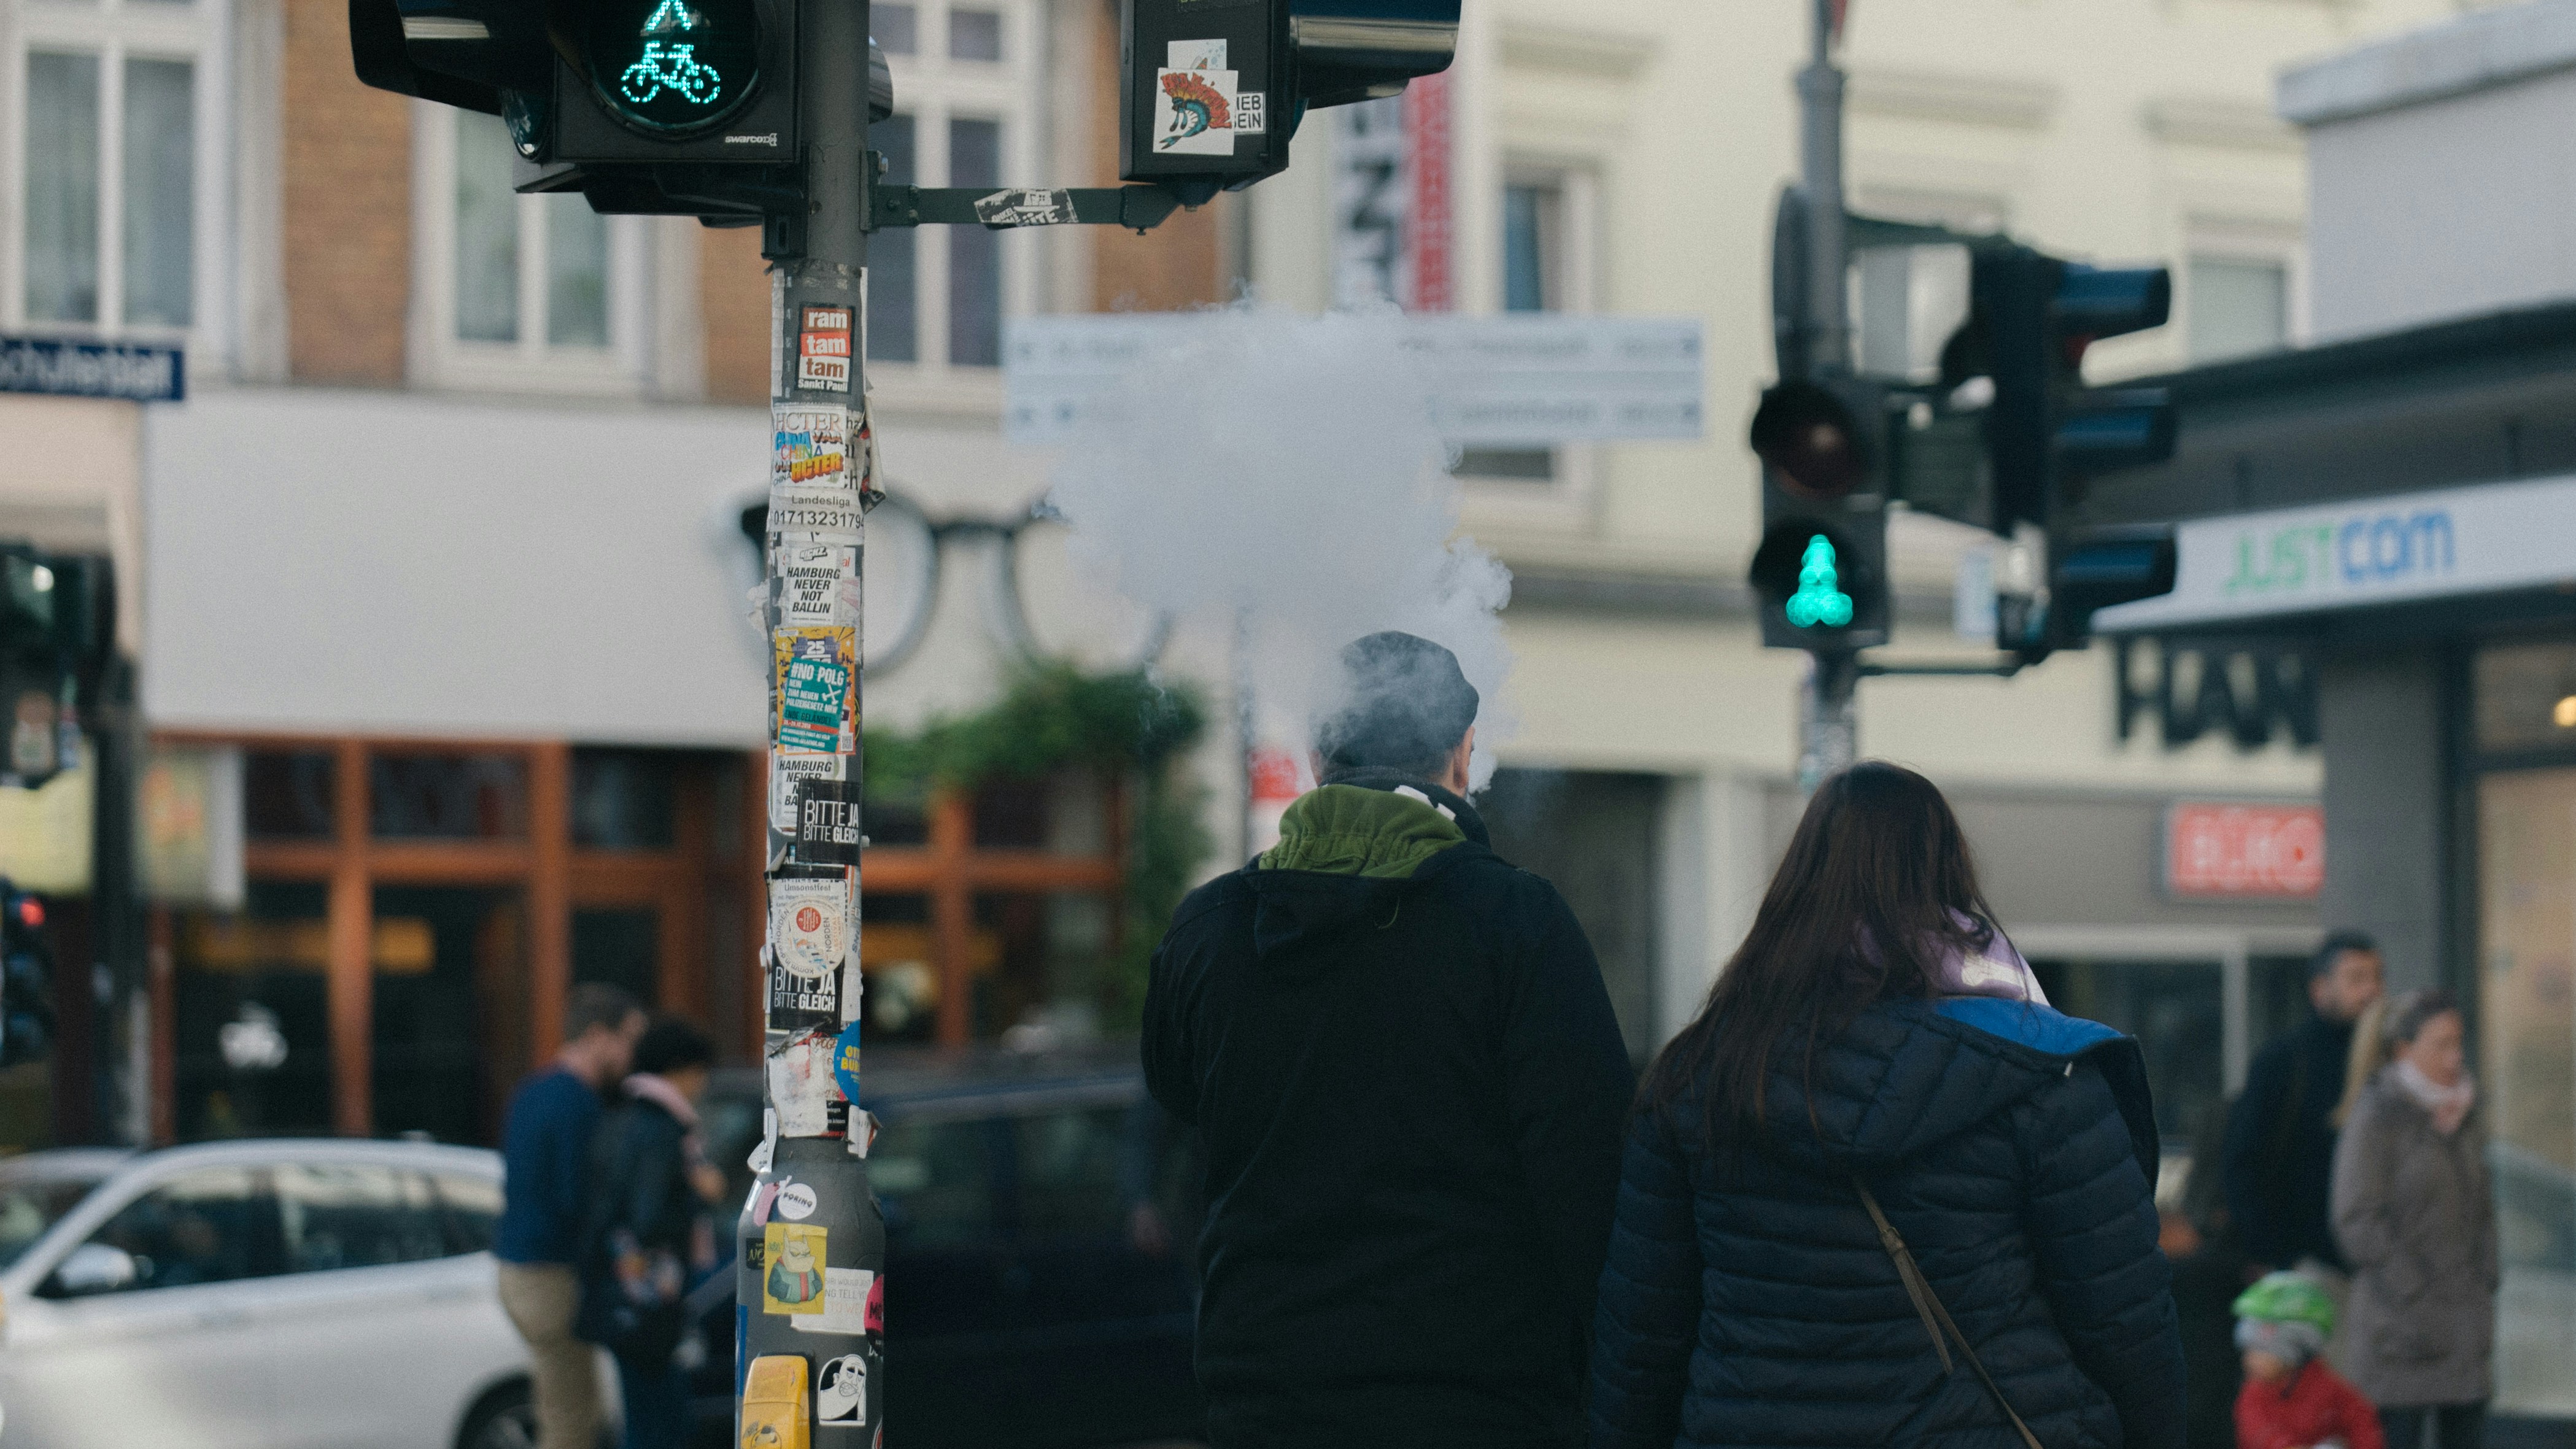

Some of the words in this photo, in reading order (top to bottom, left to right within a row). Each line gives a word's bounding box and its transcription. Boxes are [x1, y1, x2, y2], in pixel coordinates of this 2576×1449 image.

[1236, 95, 1261, 111] IEB
[1234, 112, 1262, 129] EIN
[808, 311, 848, 329] ram
[806, 334, 846, 354] tam
[806, 357, 844, 379] tam
[797, 378, 825, 390] Sankt
[826, 381, 848, 392] Pauli
[775, 412, 843, 431] HCTER
[781, 444, 823, 460] CHINA
[791, 495, 850, 508] Landesliga
[787, 566, 841, 579] HAMBURG
[794, 579, 831, 590] NEVER
[800, 590, 824, 601] NOT
[792, 602, 831, 614] BALLIN
[806, 640, 826, 655] 25
[790, 662, 815, 681] #NO
[817, 666, 845, 686] POLG
[779, 760, 832, 773] HAMBURG
[804, 799, 846, 827] BITTE
[847, 802, 859, 828] JA
[803, 824, 831, 842] BITTE
[832, 826, 859, 845] GLEICH
[822, 917, 832, 952] NORDEN
[775, 966, 814, 994] BITTE
[816, 970, 835, 995] JA
[774, 991, 797, 1009] BITTE
[798, 993, 835, 1012] GLEICH
